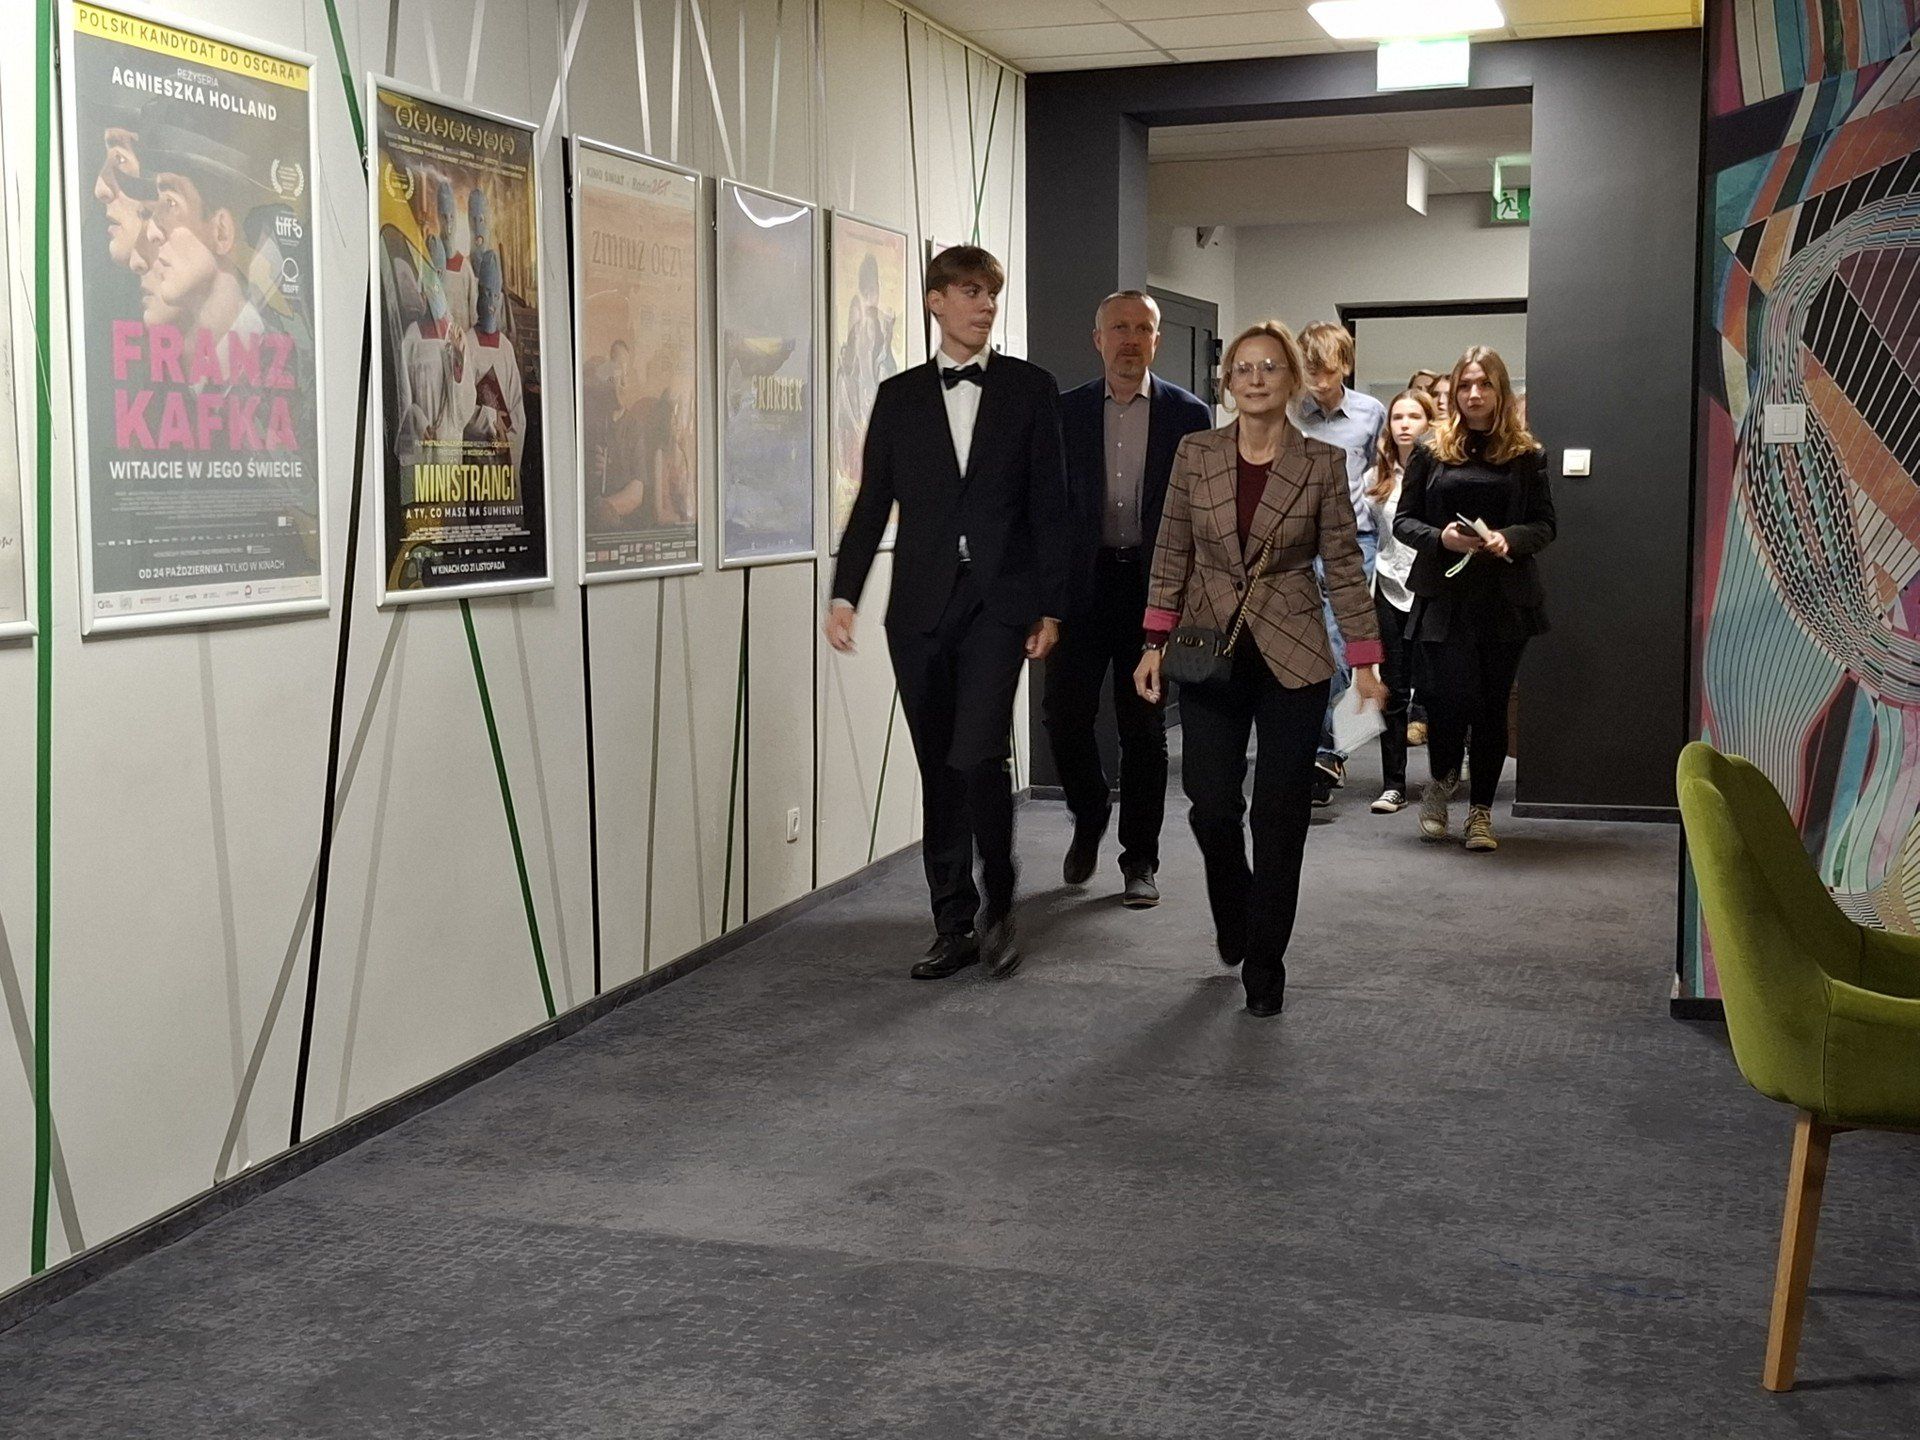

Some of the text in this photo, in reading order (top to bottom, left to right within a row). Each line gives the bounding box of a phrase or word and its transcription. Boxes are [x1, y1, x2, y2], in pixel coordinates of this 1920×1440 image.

[80, 9, 134, 37] POLSKI
[140, 25, 216, 59] KANDYDAT
[221, 48, 239, 65] DO
[111, 65, 277, 121] AGNIESZKA HOLLAND
[112, 319, 296, 390] FRANZ
[751, 374, 803, 412] SKARBEK
[115, 389, 299, 451] KAFKA
[109, 457, 302, 480] WITAJCIE W JEGO ŚWIECIE
[414, 464, 515, 503] MINISTRANCI
[406, 508, 412, 519] A
[430, 507, 442, 518] CO
[445, 506, 467, 518] MASZ
[469, 505, 480, 517] NA
[139, 568, 152, 579] OD
[153, 567, 164, 578] 24
[225, 561, 248, 573] TYLKO
[249, 561, 257, 571] W
[431, 565, 438, 576] W
[460, 563, 470, 574] OD
